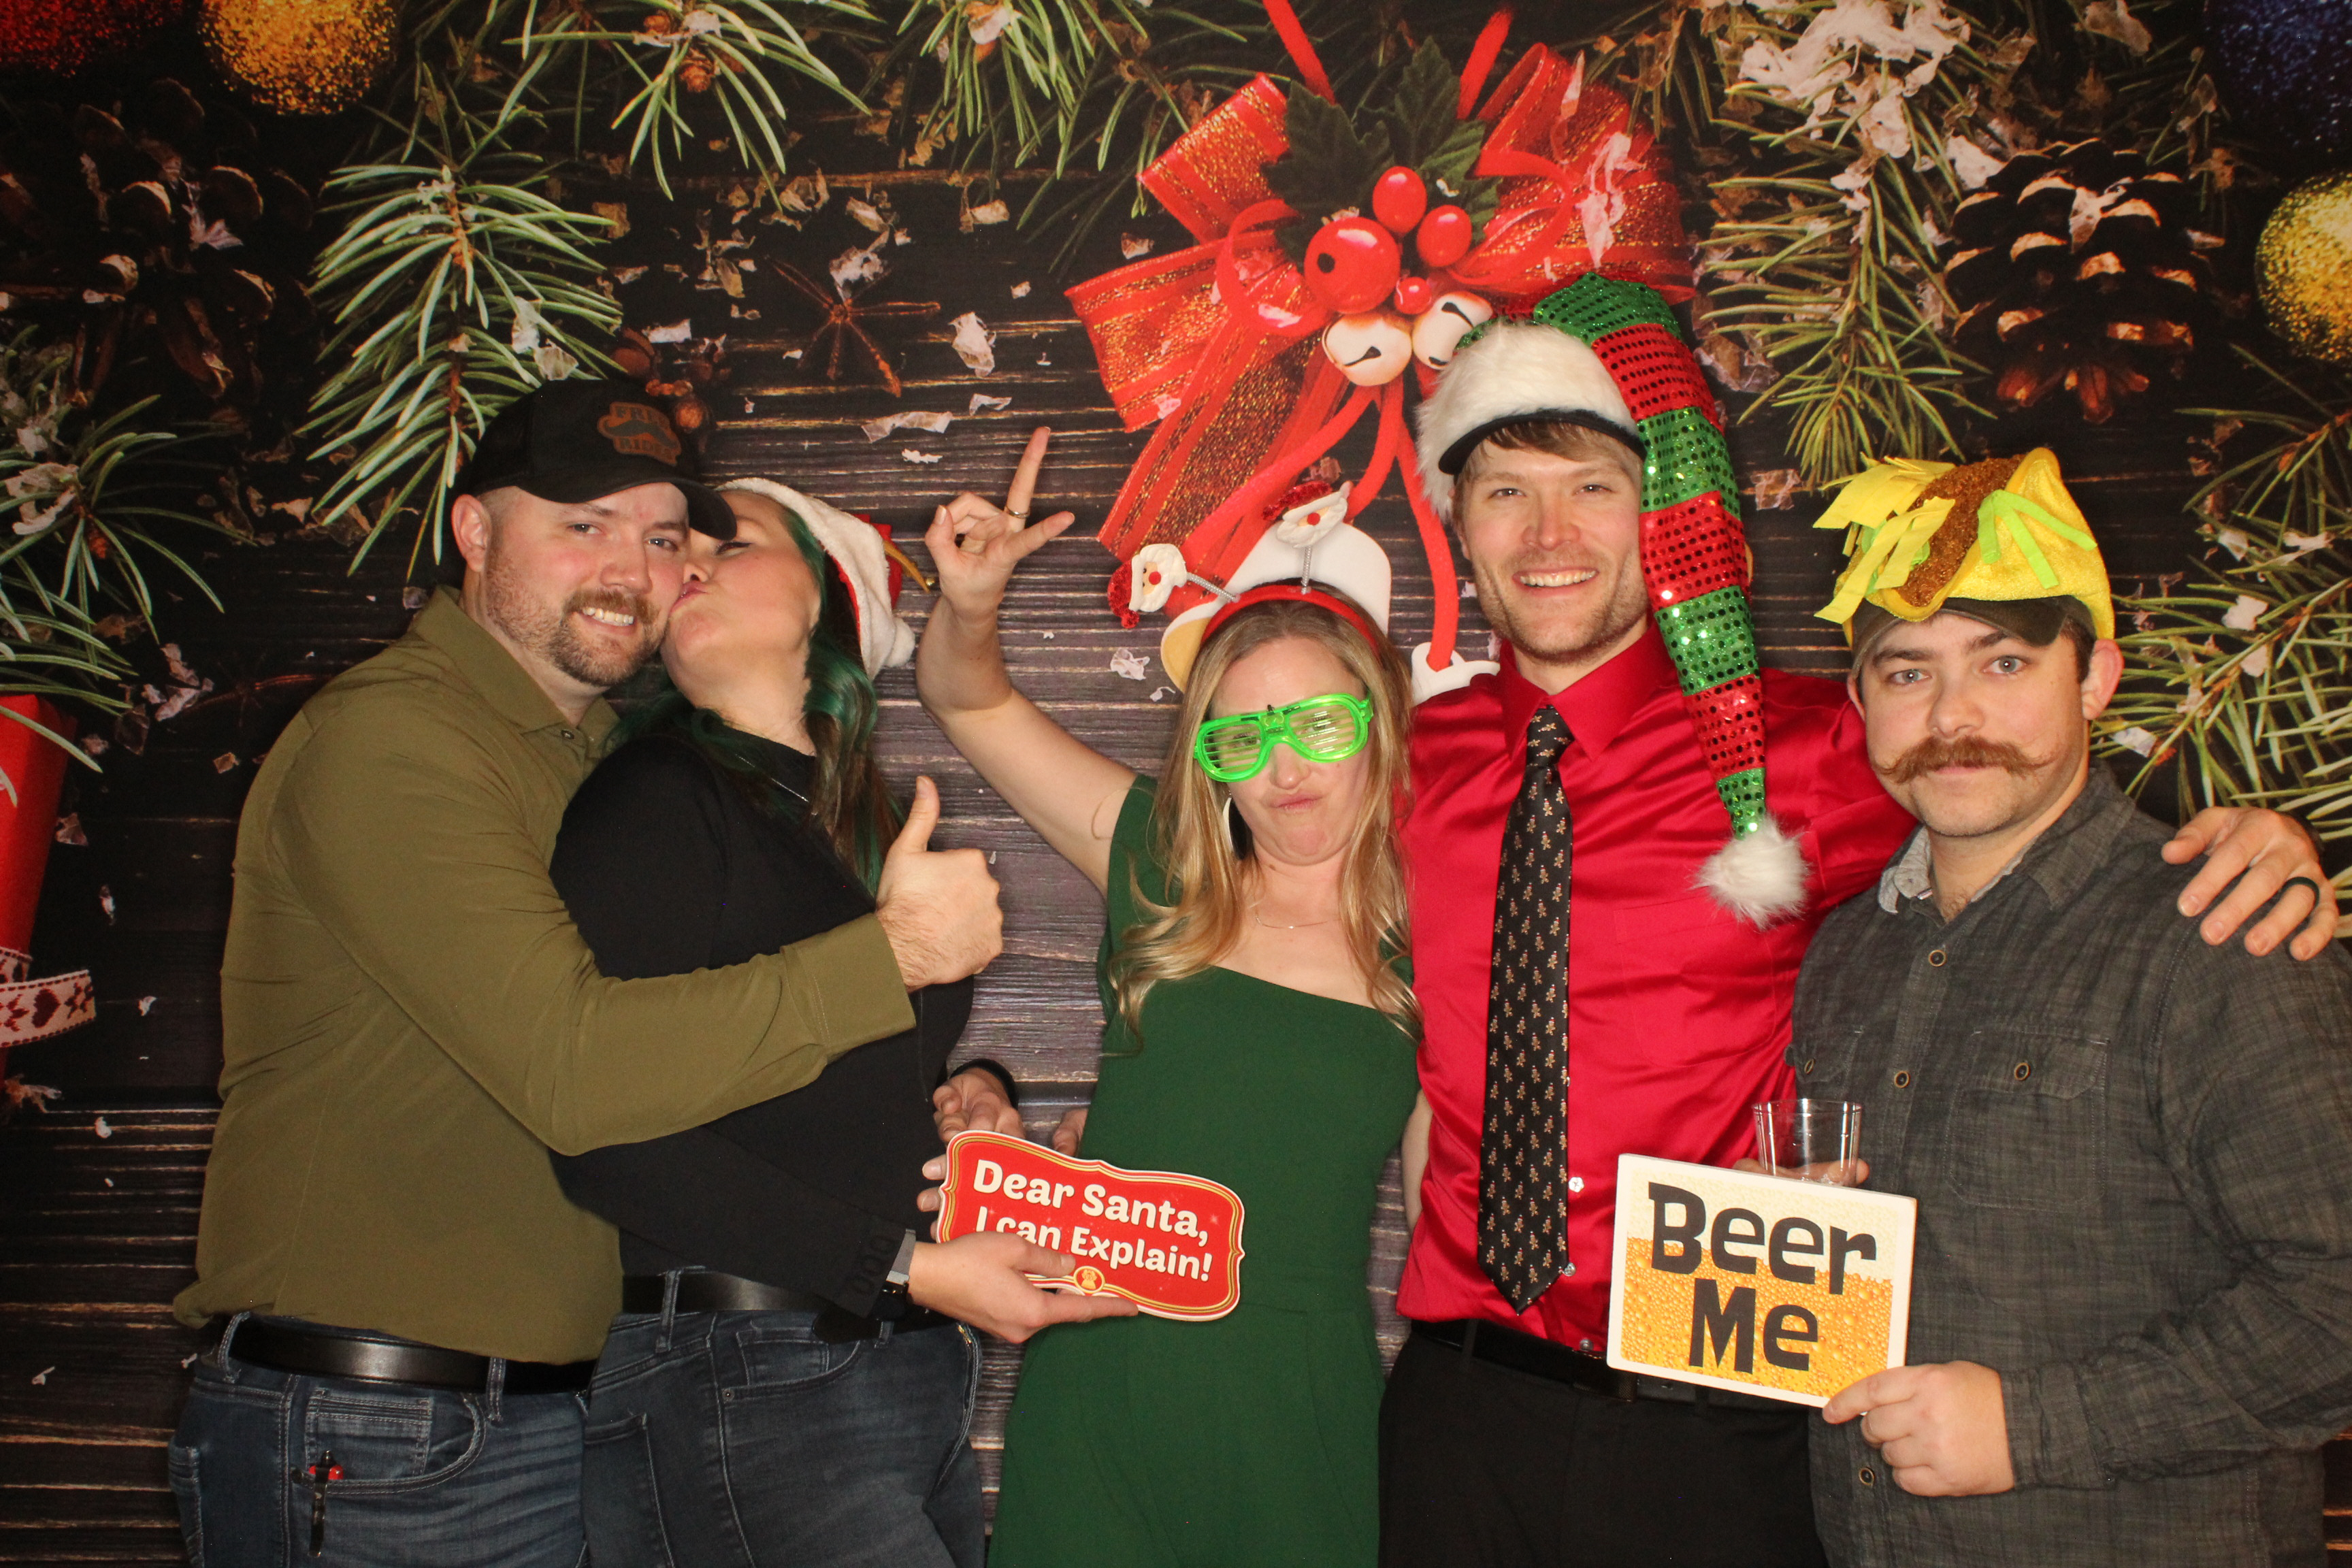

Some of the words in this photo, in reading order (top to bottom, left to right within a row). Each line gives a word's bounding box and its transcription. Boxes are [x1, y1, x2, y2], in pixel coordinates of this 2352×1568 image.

[973, 1159, 1075, 1209] Dear
[1081, 1183, 1209, 1247] Santa,
[976, 1206, 987, 1232] I
[1071, 1226, 1213, 1282] Explain!
[1648, 1181, 1877, 1295] Beer
[1688, 1277, 1818, 1375] Me
